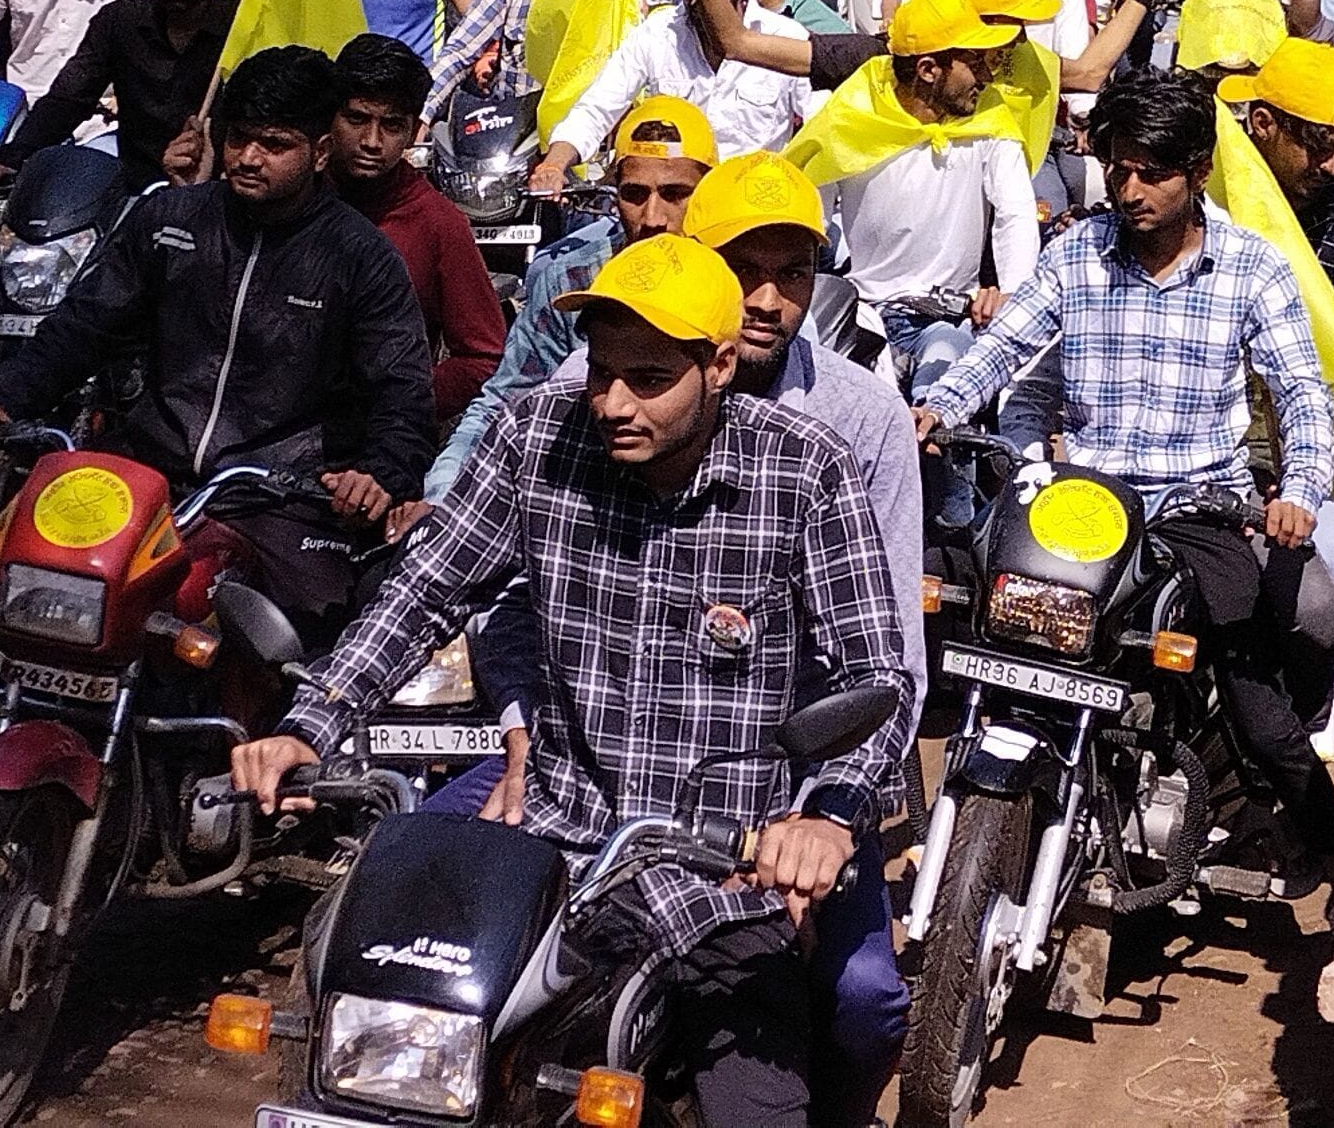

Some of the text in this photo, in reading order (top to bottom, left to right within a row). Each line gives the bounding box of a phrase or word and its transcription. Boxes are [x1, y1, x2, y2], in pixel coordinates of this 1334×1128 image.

[300, 536, 352, 555] Supreme
[966, 654, 1119, 708] HR36 AJ 8569
[368, 728, 502, 751] HR 34 L 7880
